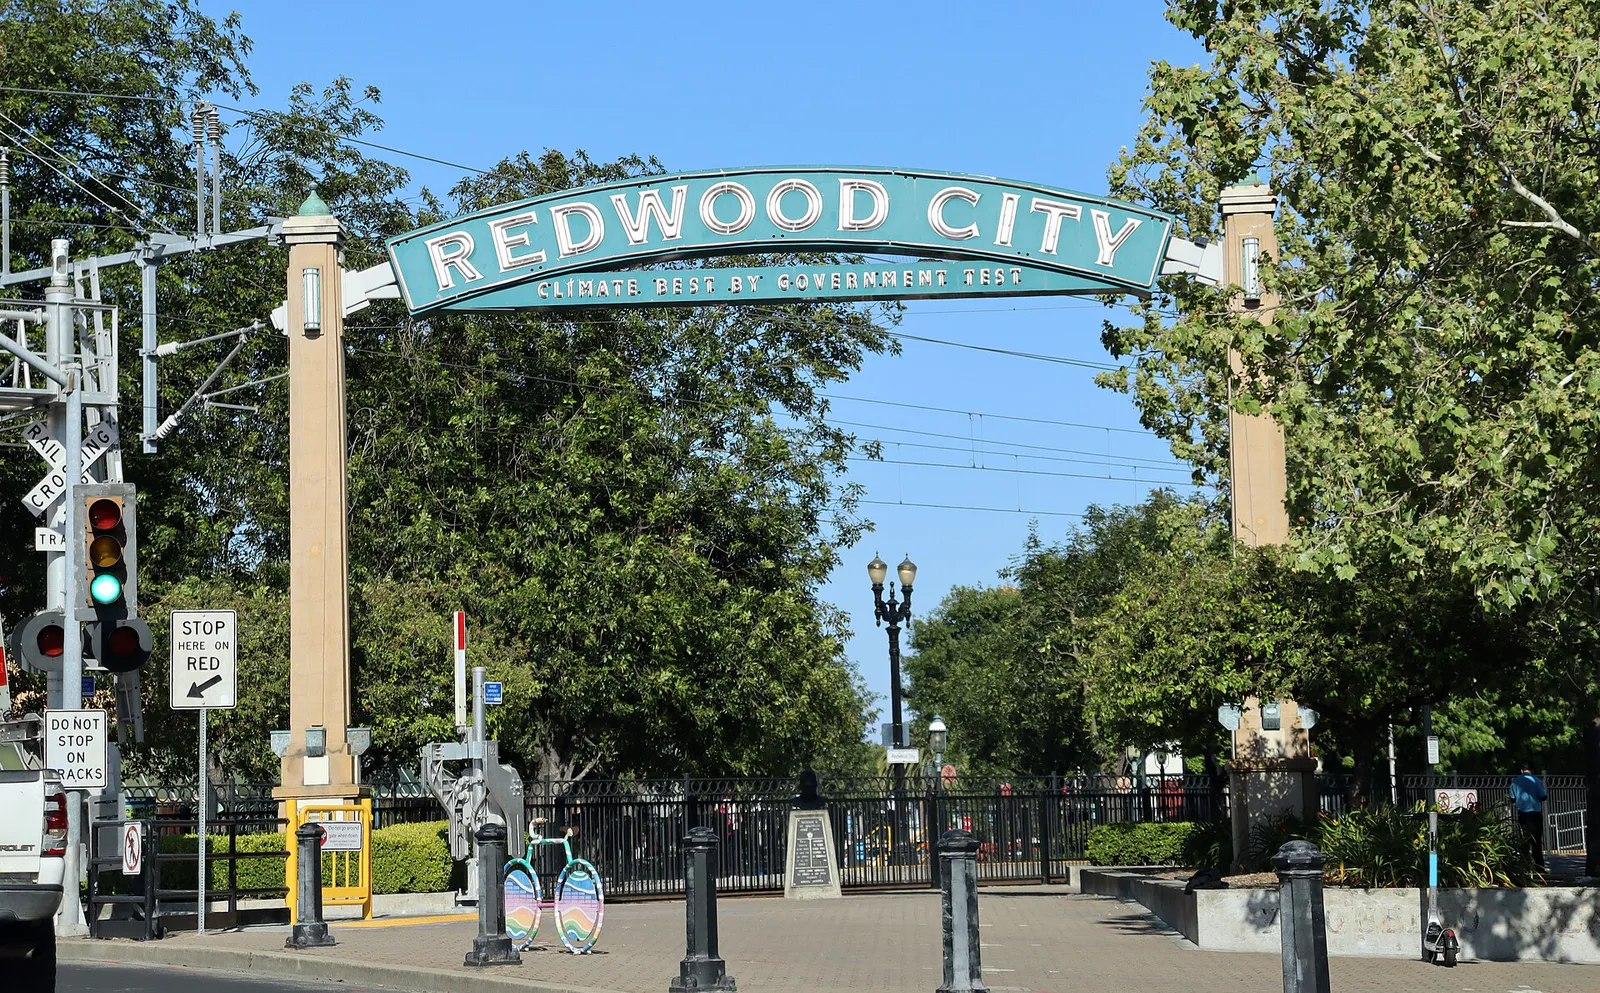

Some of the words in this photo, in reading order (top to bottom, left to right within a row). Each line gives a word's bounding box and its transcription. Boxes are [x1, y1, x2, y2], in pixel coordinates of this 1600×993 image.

[423, 177, 890, 292] REDWOOD
[927, 185, 1143, 268] CITY
[537, 277, 639, 299] CLIMATE
[655, 275, 715, 296] BEST
[731, 275, 760, 294] BY
[777, 269, 948, 292] GOVERNMENT
[963, 267, 1022, 286] TEST
[27, 424, 60, 463] RAIL
[31, 430, 110, 508] CROING
[39, 533, 66, 545] TRA
[182, 620, 225, 636] STOP
[178, 641, 205, 650] HERE
[214, 641, 229, 650] ON
[187, 656, 220, 671] RED
[51, 718, 69, 730] DO
[73, 718, 99, 730] NOT
[58, 735, 94, 747] STOP
[67, 752, 85, 763] ON
[57, 768, 102, 780] RACKS
[0, 844, 36, 852] ROLET
